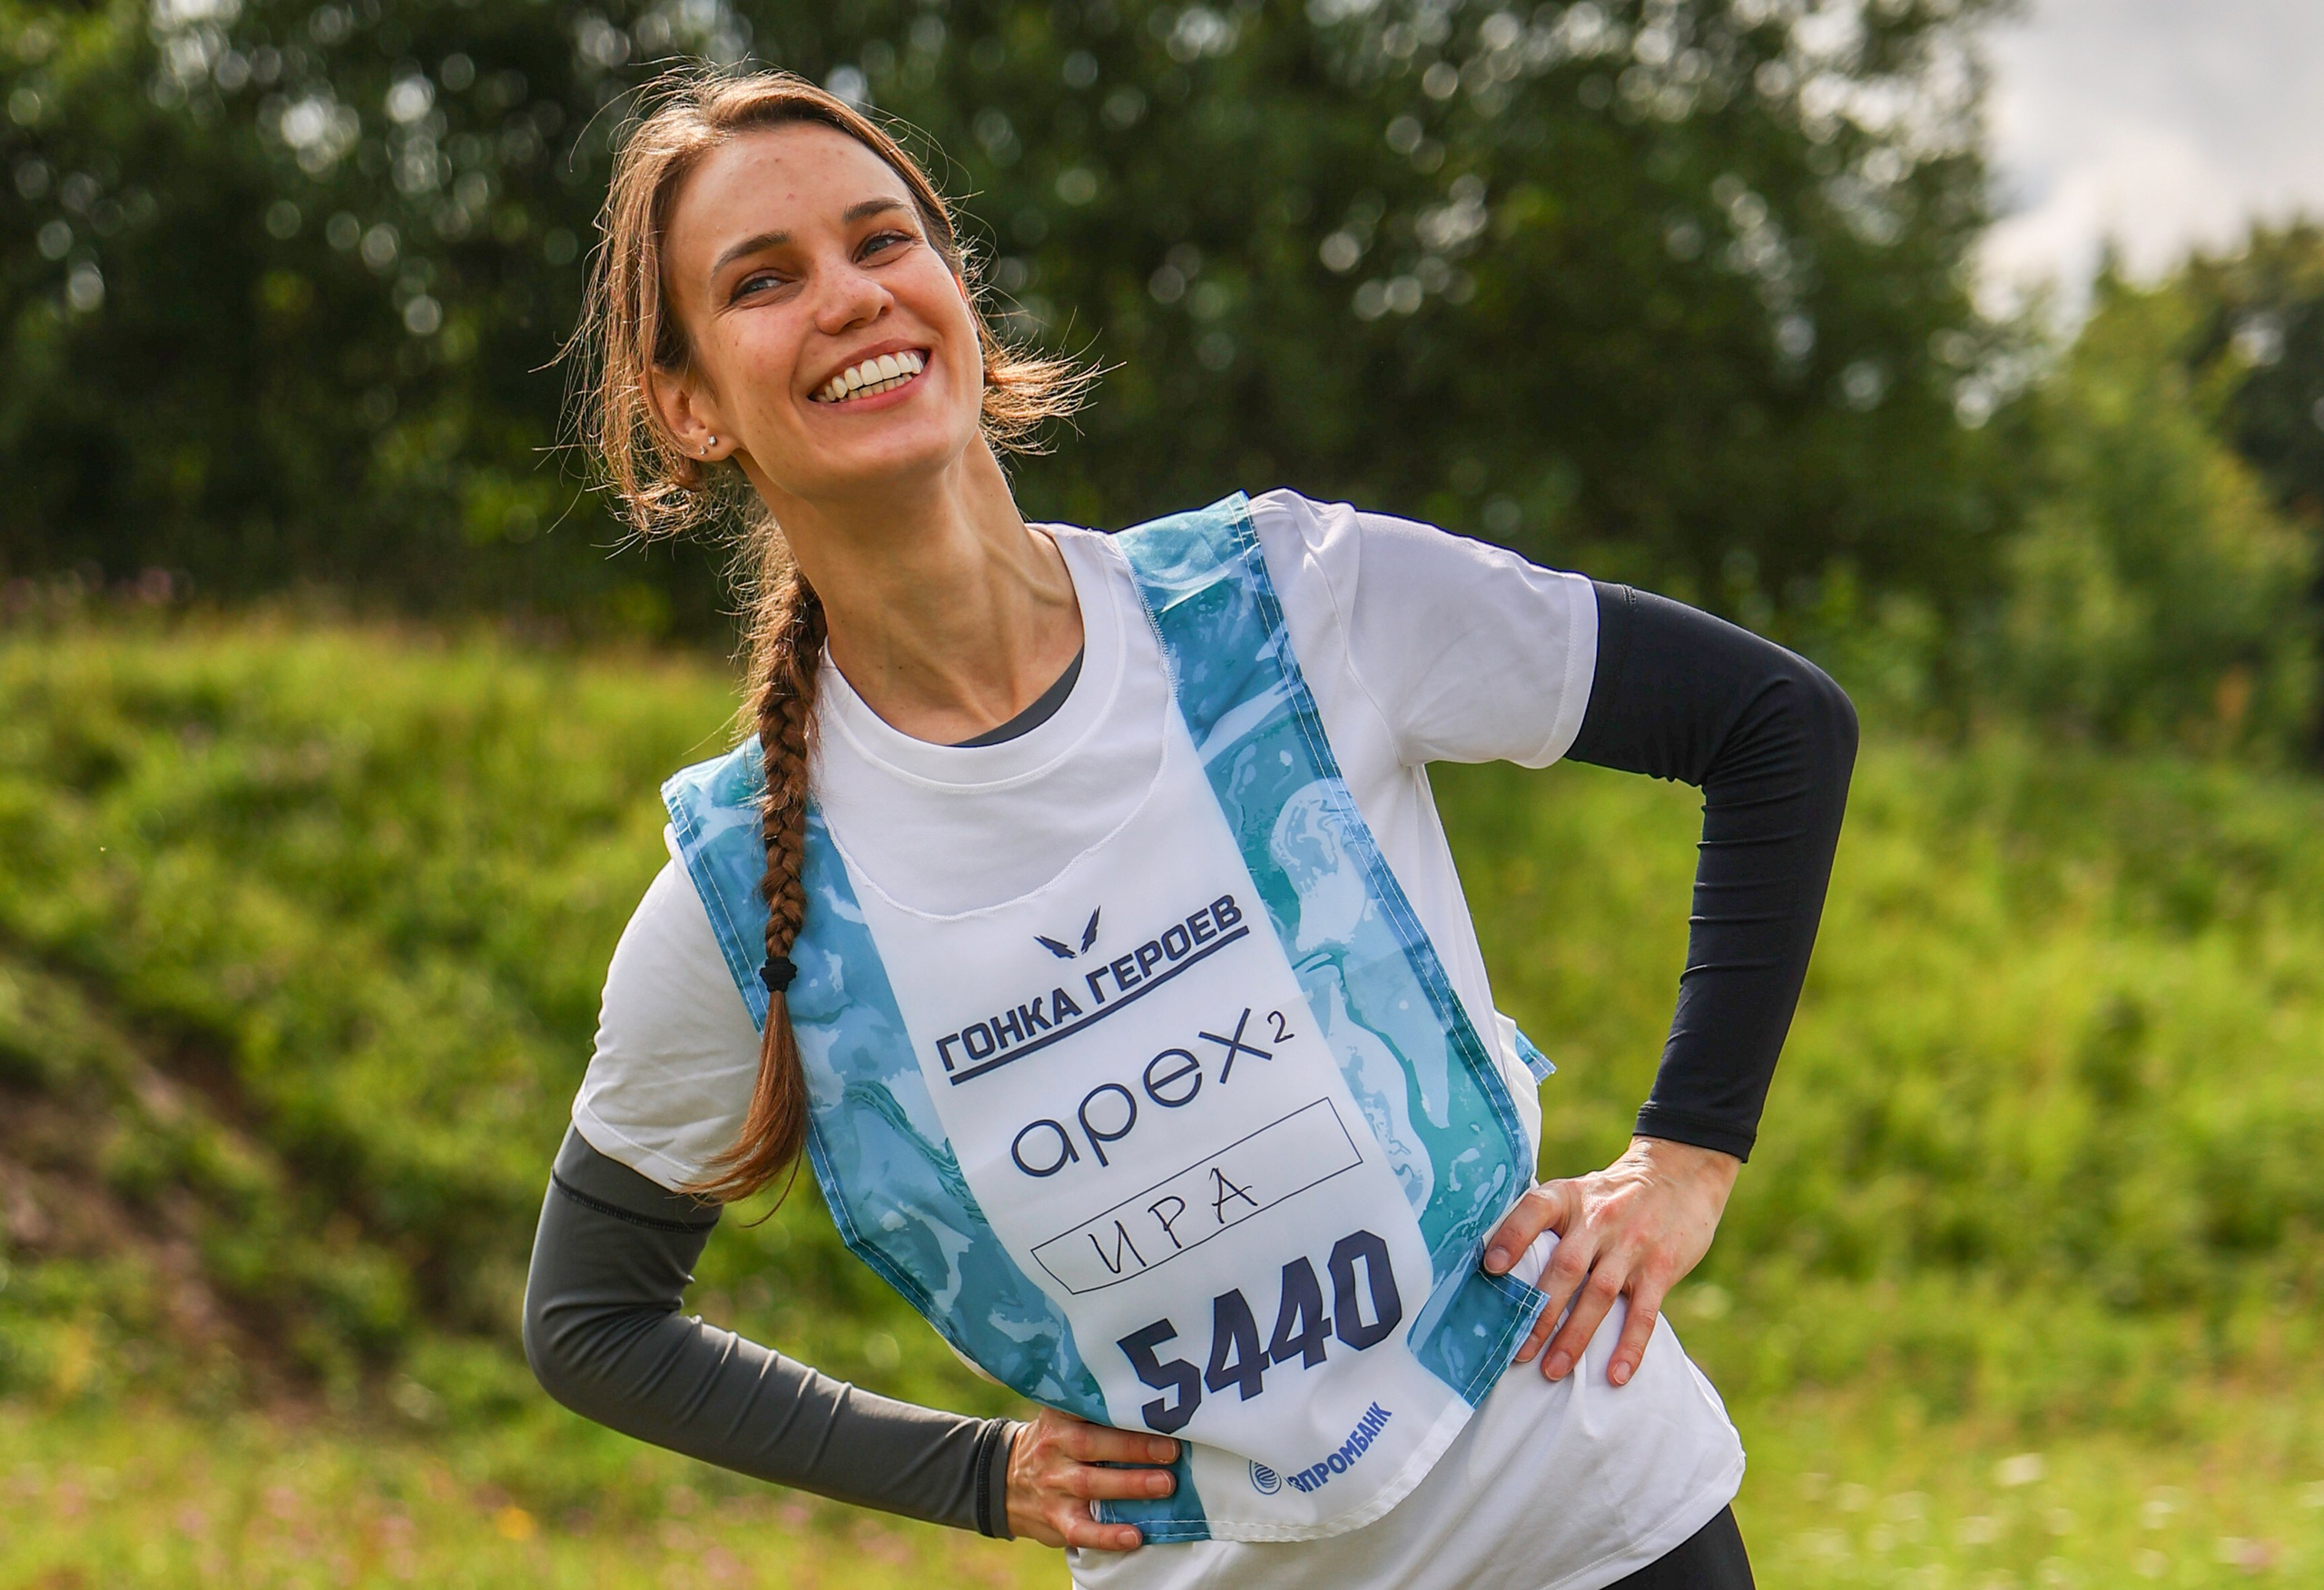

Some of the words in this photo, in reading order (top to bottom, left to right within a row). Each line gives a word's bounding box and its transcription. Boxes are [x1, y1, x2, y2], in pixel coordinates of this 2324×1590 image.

[935, 986, 1083, 1072] ГОНКА
[1085, 894, 1243, 1004] ГЕРОЕВ
[1088, 1167, 1258, 1273] ИРА
[1116, 1229, 1403, 1435] 5440
[1283, 1400, 1393, 1493] ЗПРОМБАНК
